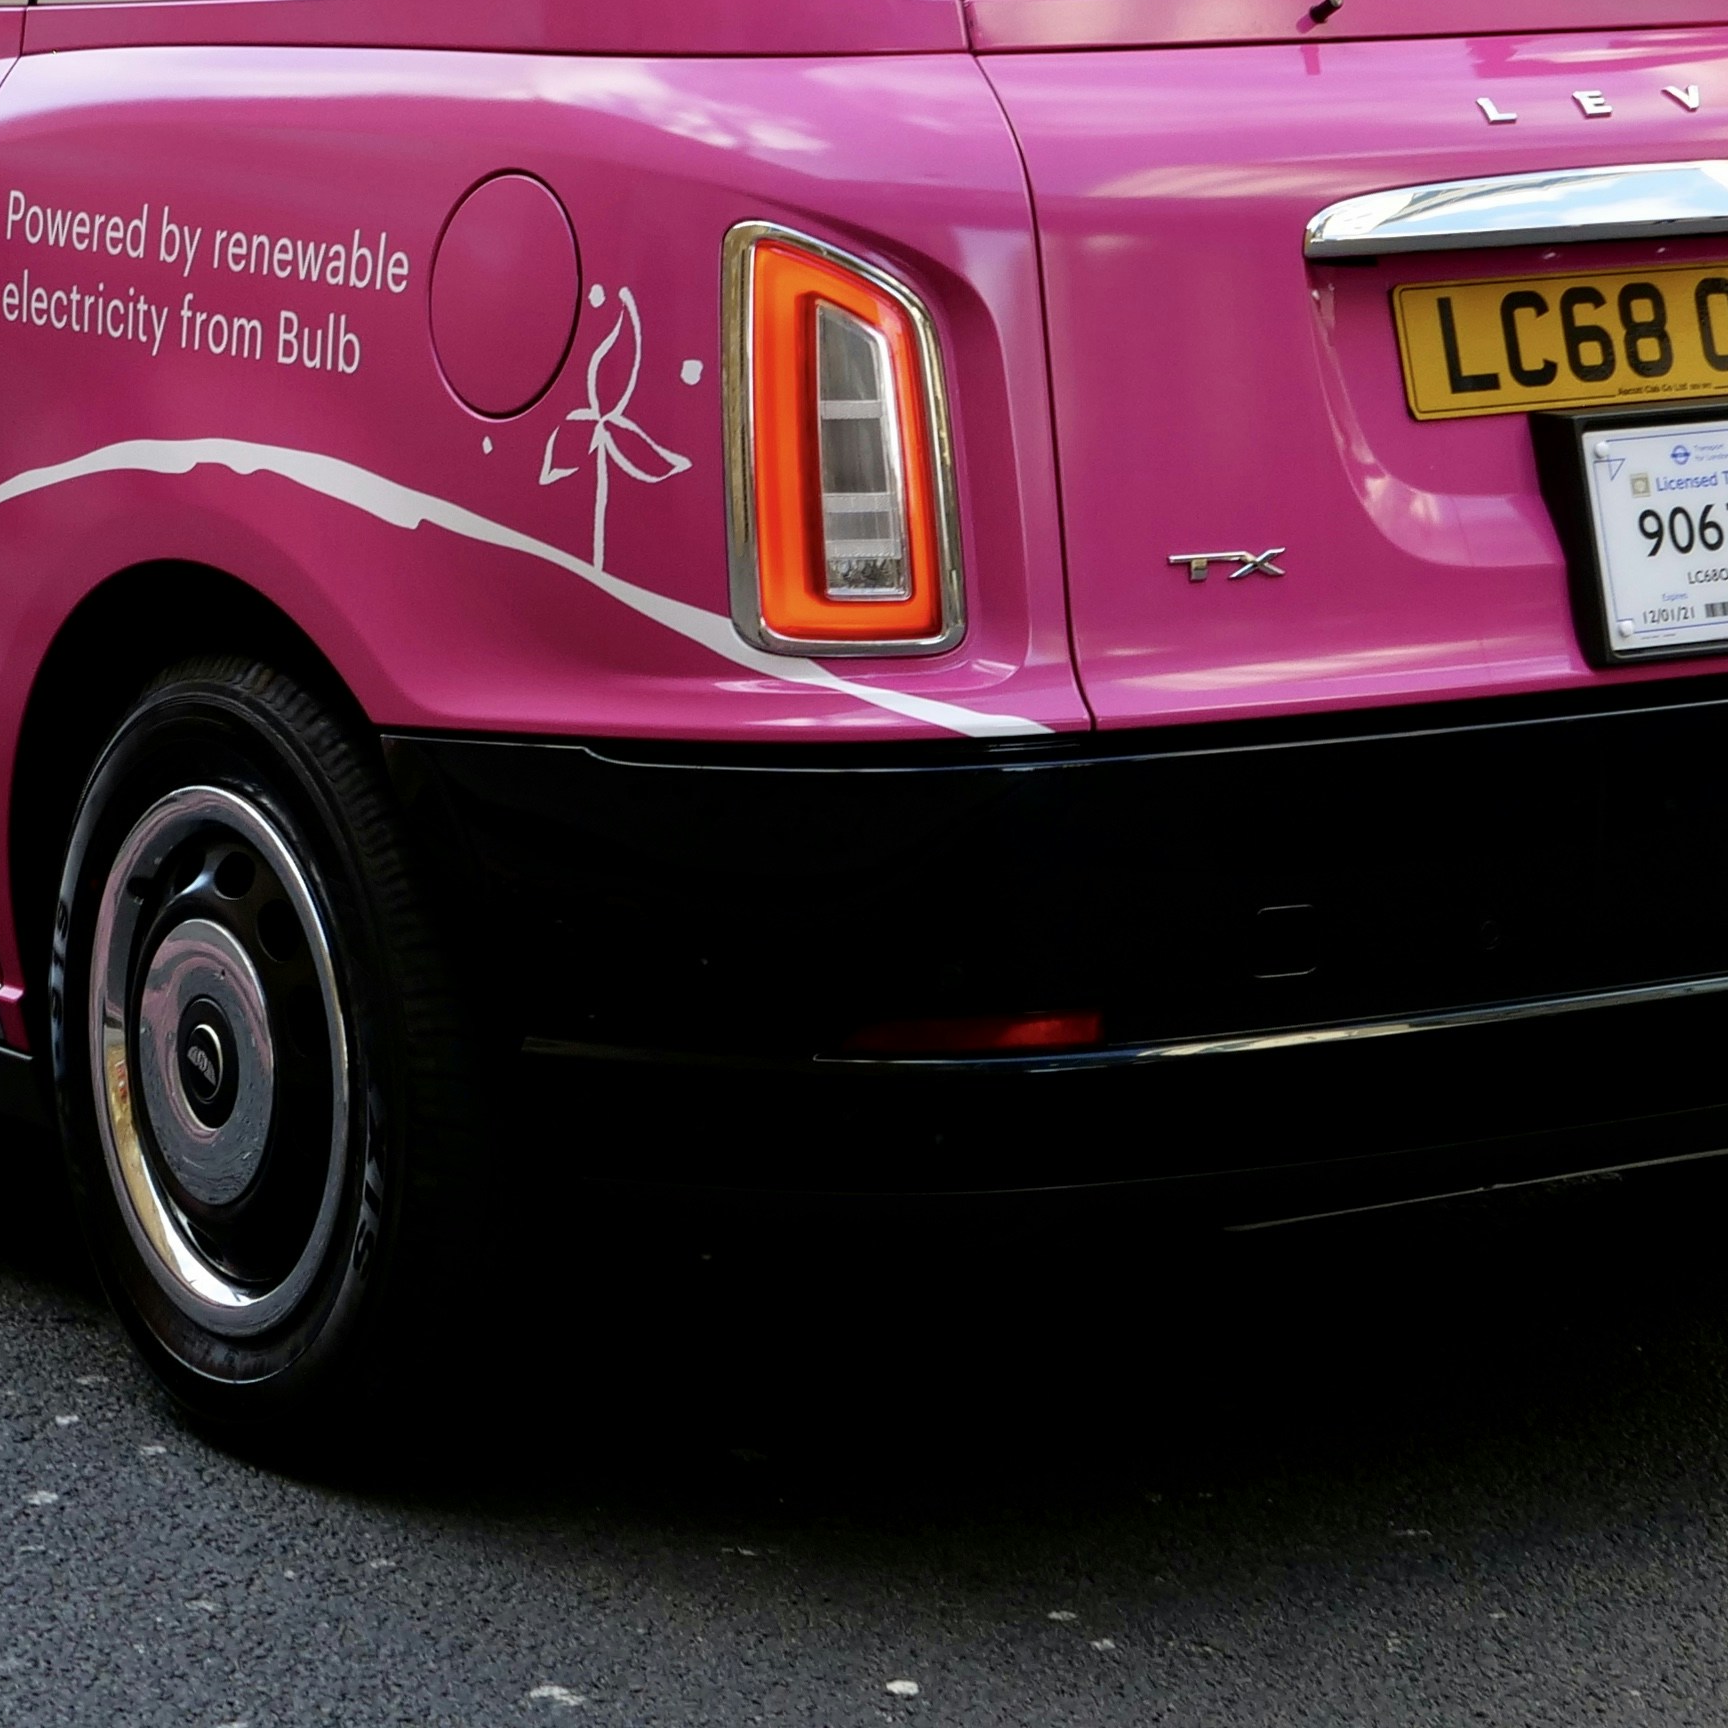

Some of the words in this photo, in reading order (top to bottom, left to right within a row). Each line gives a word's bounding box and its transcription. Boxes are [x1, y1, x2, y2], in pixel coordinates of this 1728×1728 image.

[5, 188, 147, 261] Powered
[159, 205, 201, 273] by
[213, 228, 410, 294] renewable
[1, 268, 168, 357] electricity
[180, 291, 263, 361] from
[277, 309, 361, 375] Bulb
[1435, 280, 1674, 396] LC68
[1656, 472, 1718, 492] Licensed
[1168, 546, 1286, 582] TX
[1642, 606, 1696, 625] 12/01/21
